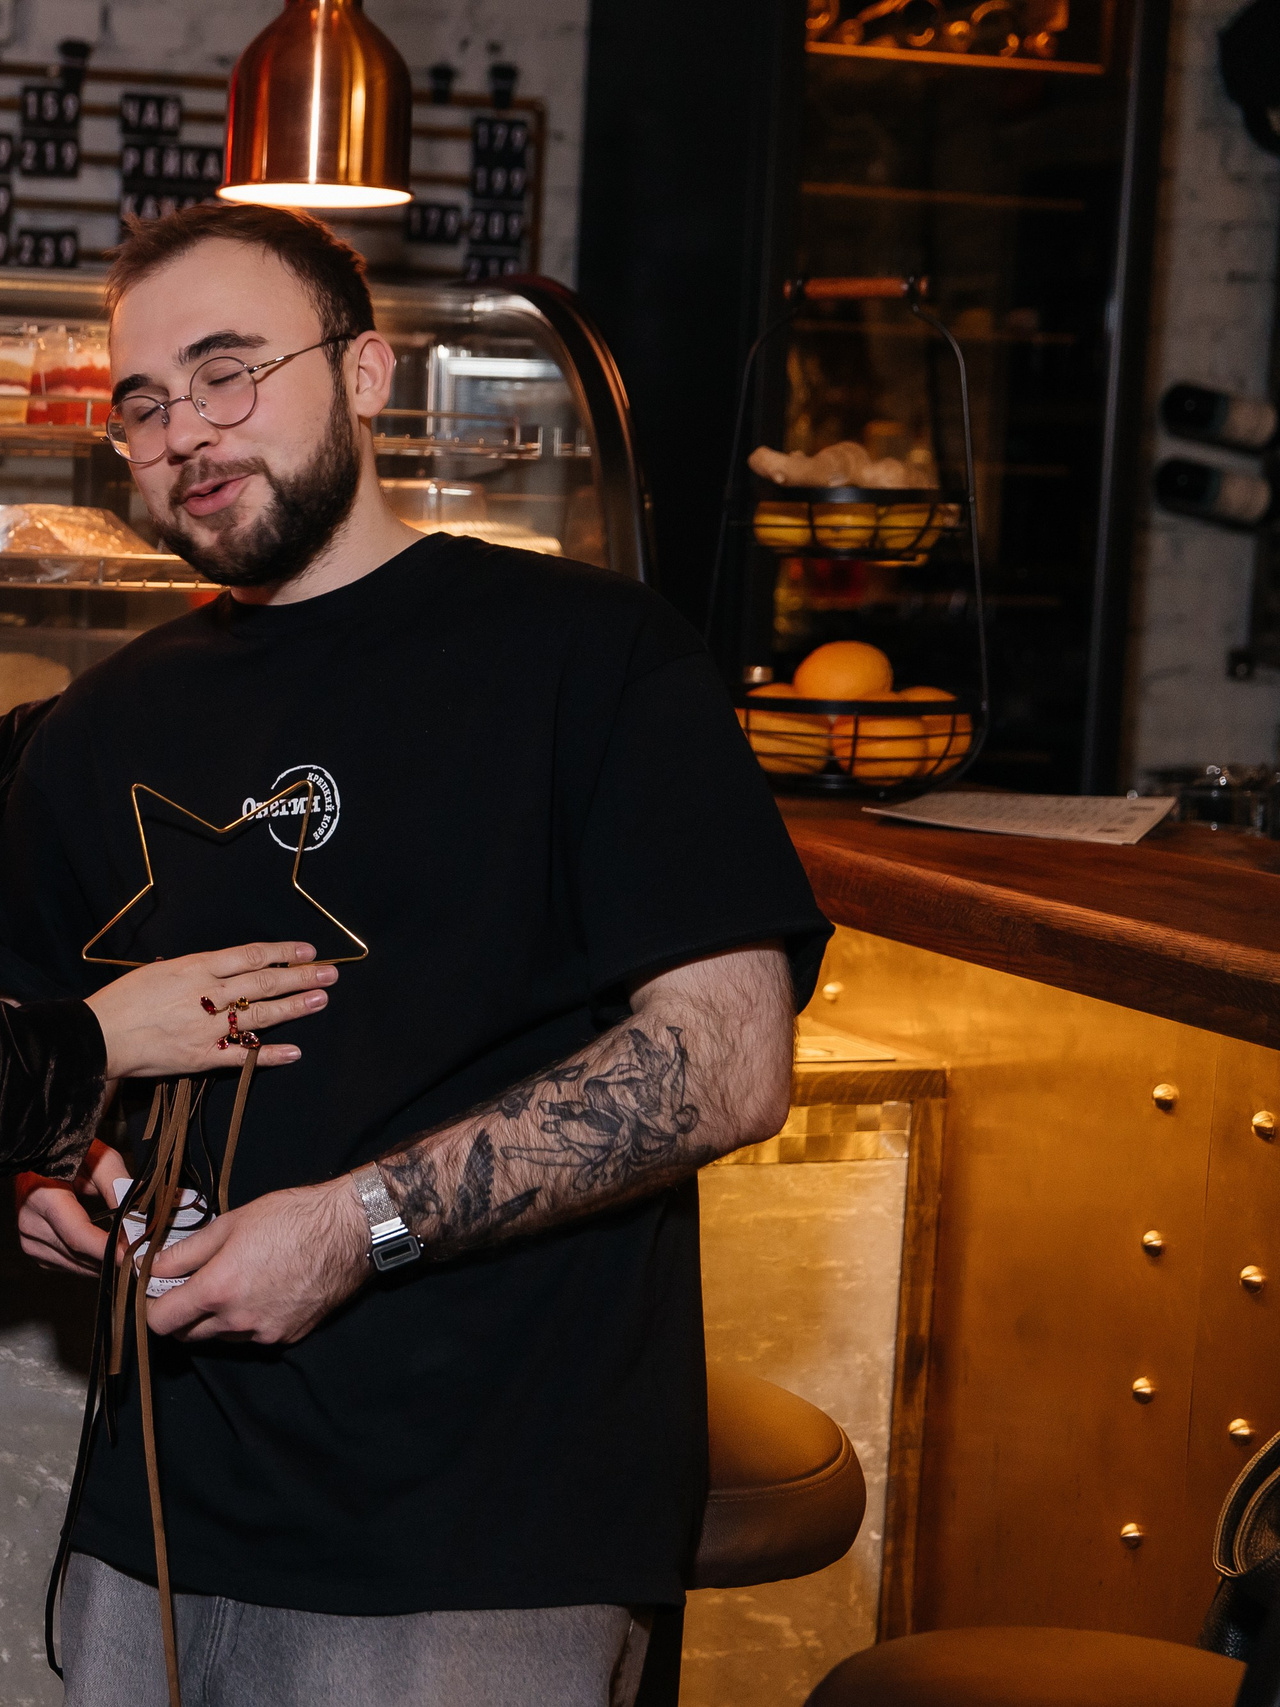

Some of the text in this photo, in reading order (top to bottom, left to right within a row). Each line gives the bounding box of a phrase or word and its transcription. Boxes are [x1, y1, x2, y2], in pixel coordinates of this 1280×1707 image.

[22, 139, 78, 171] 219
[306, 772, 335, 841] КРЕПКИЙ КОФЕ
